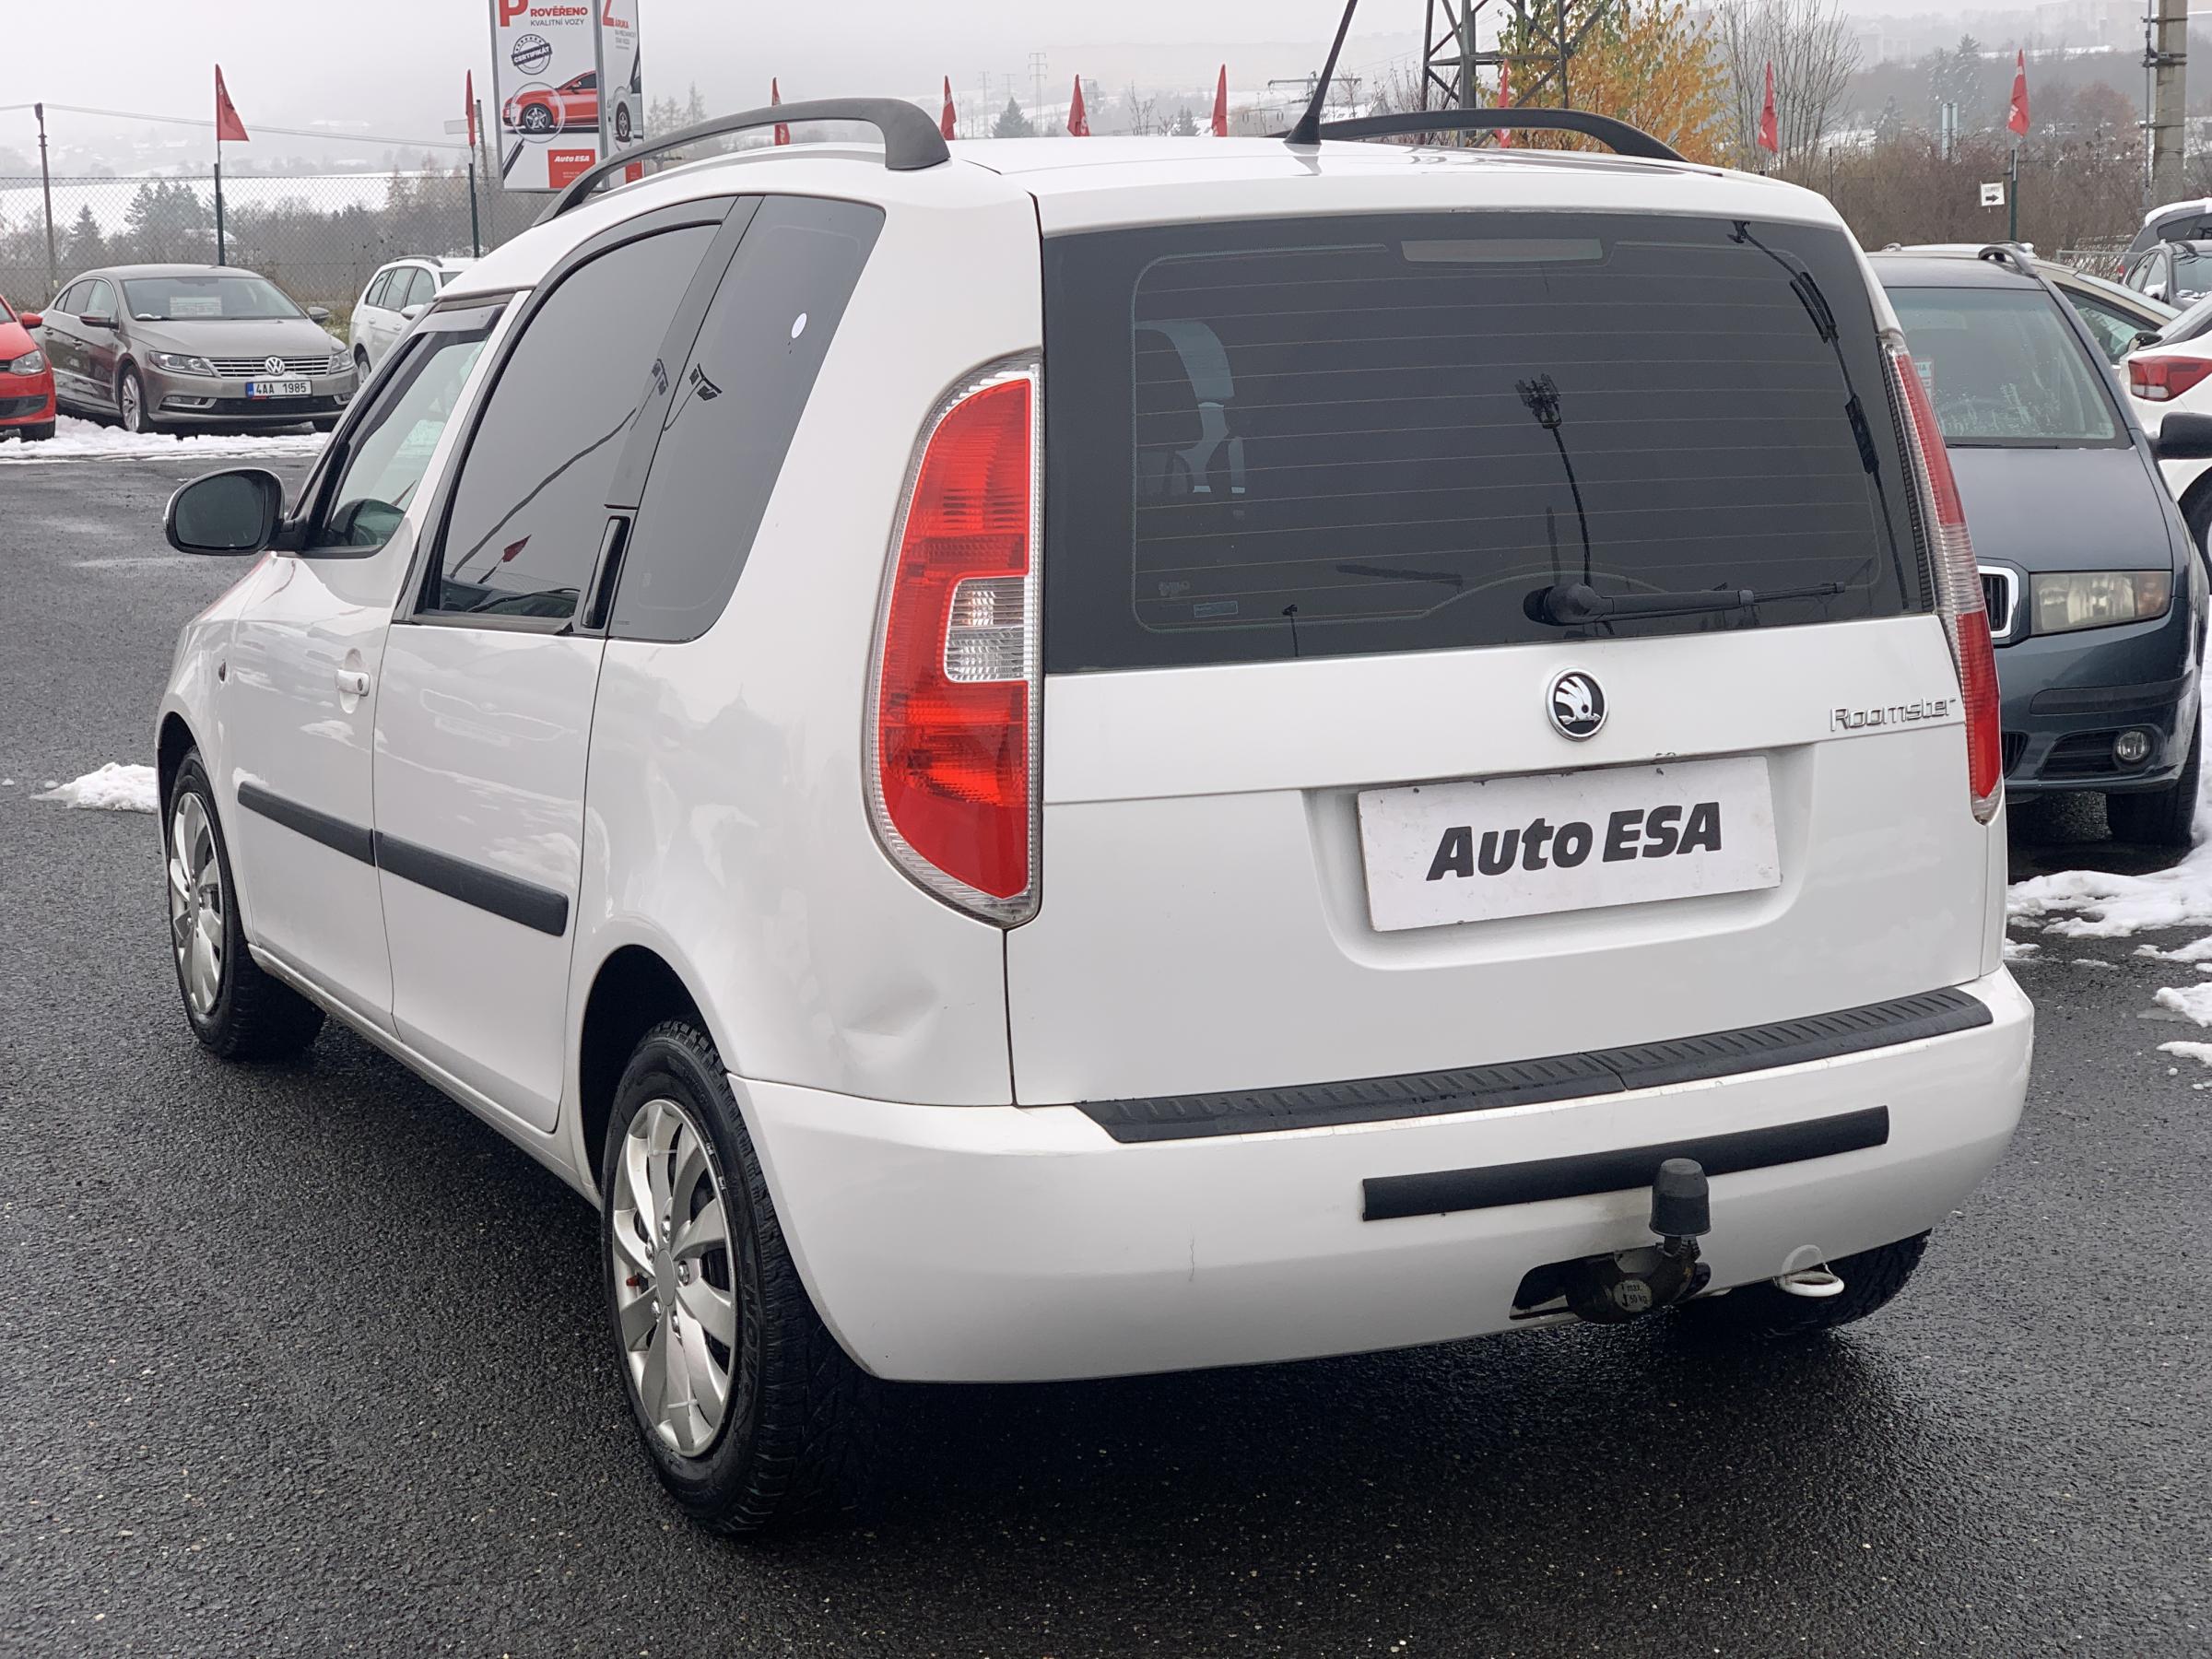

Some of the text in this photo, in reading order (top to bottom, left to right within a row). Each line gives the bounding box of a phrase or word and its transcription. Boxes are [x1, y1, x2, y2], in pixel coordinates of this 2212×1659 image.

[531, 18, 563, 27] KVALITNÍ
[554, 155, 573, 163] Auto
[256, 382, 307, 394] 4AA 1985
[1830, 698, 1957, 732] Roomster
[1426, 801, 1722, 881] Auto ESA
